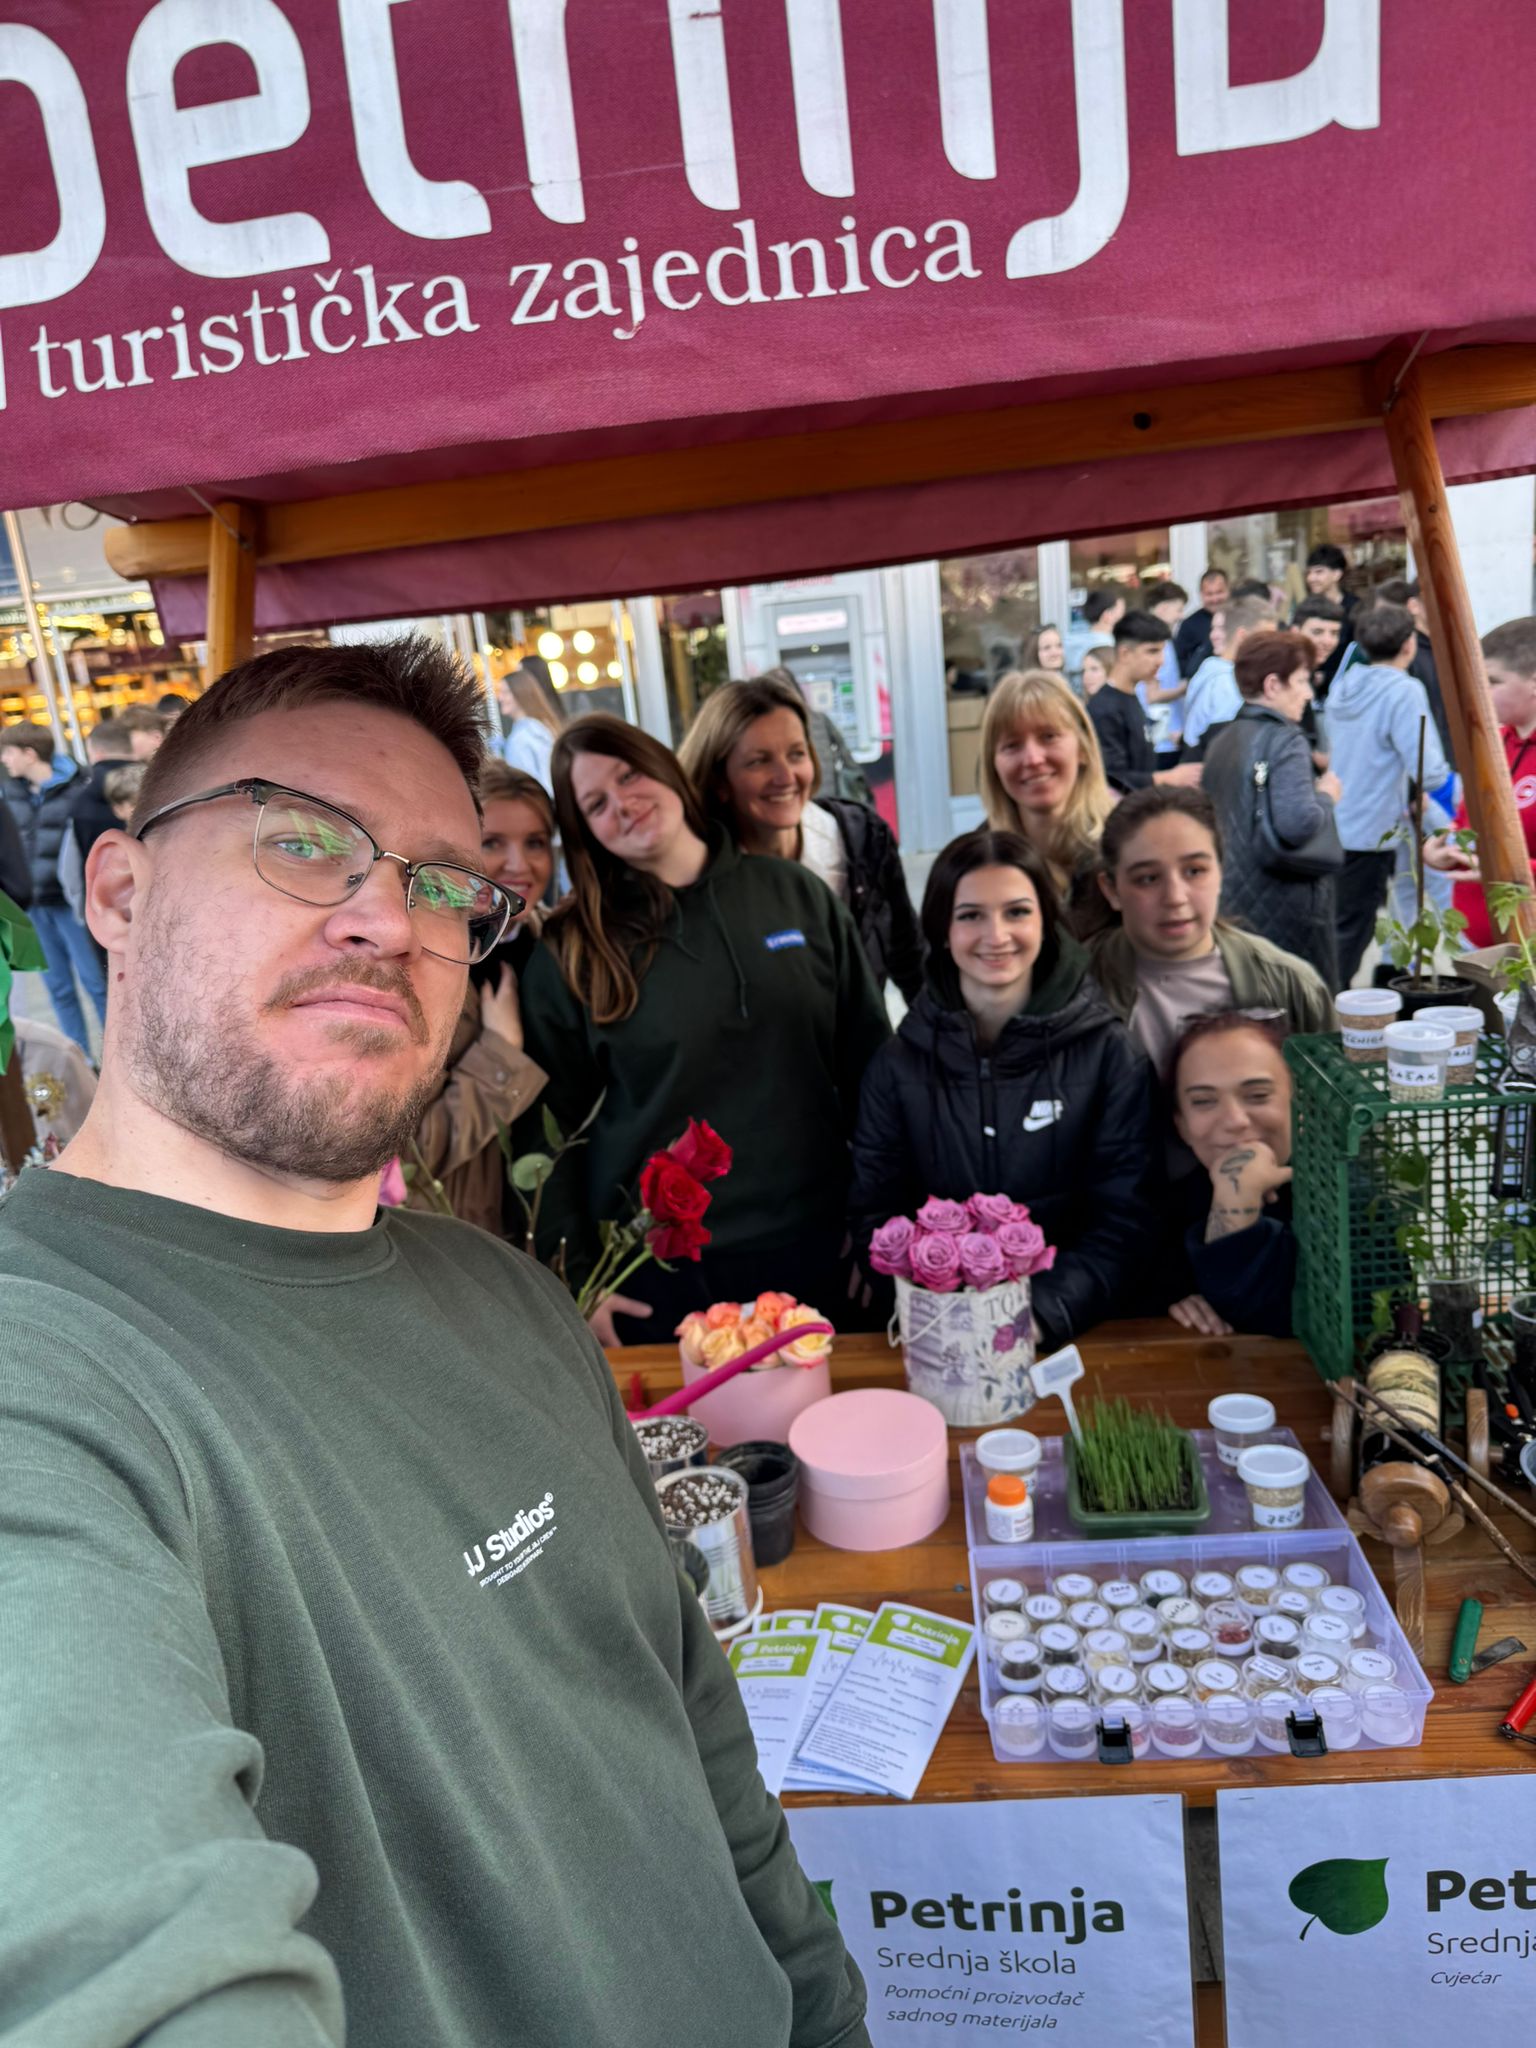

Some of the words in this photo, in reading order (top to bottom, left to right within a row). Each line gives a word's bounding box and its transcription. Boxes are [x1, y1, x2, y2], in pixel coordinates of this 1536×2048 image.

[29, 264, 480, 399] turistička
[508, 215, 982, 340] zajednica
[870, 1886, 1125, 1945] Petrinja
[877, 1945, 990, 1976] Srednja
[999, 1950, 1076, 1975] škola
[1430, 1970, 1502, 1988] Cvjećar
[884, 1984, 970, 2001] Pomoćni
[972, 1990, 1086, 2007] proizvođač
[886, 2007, 958, 2026] sadnog
[962, 2013, 1058, 2032] materijala
